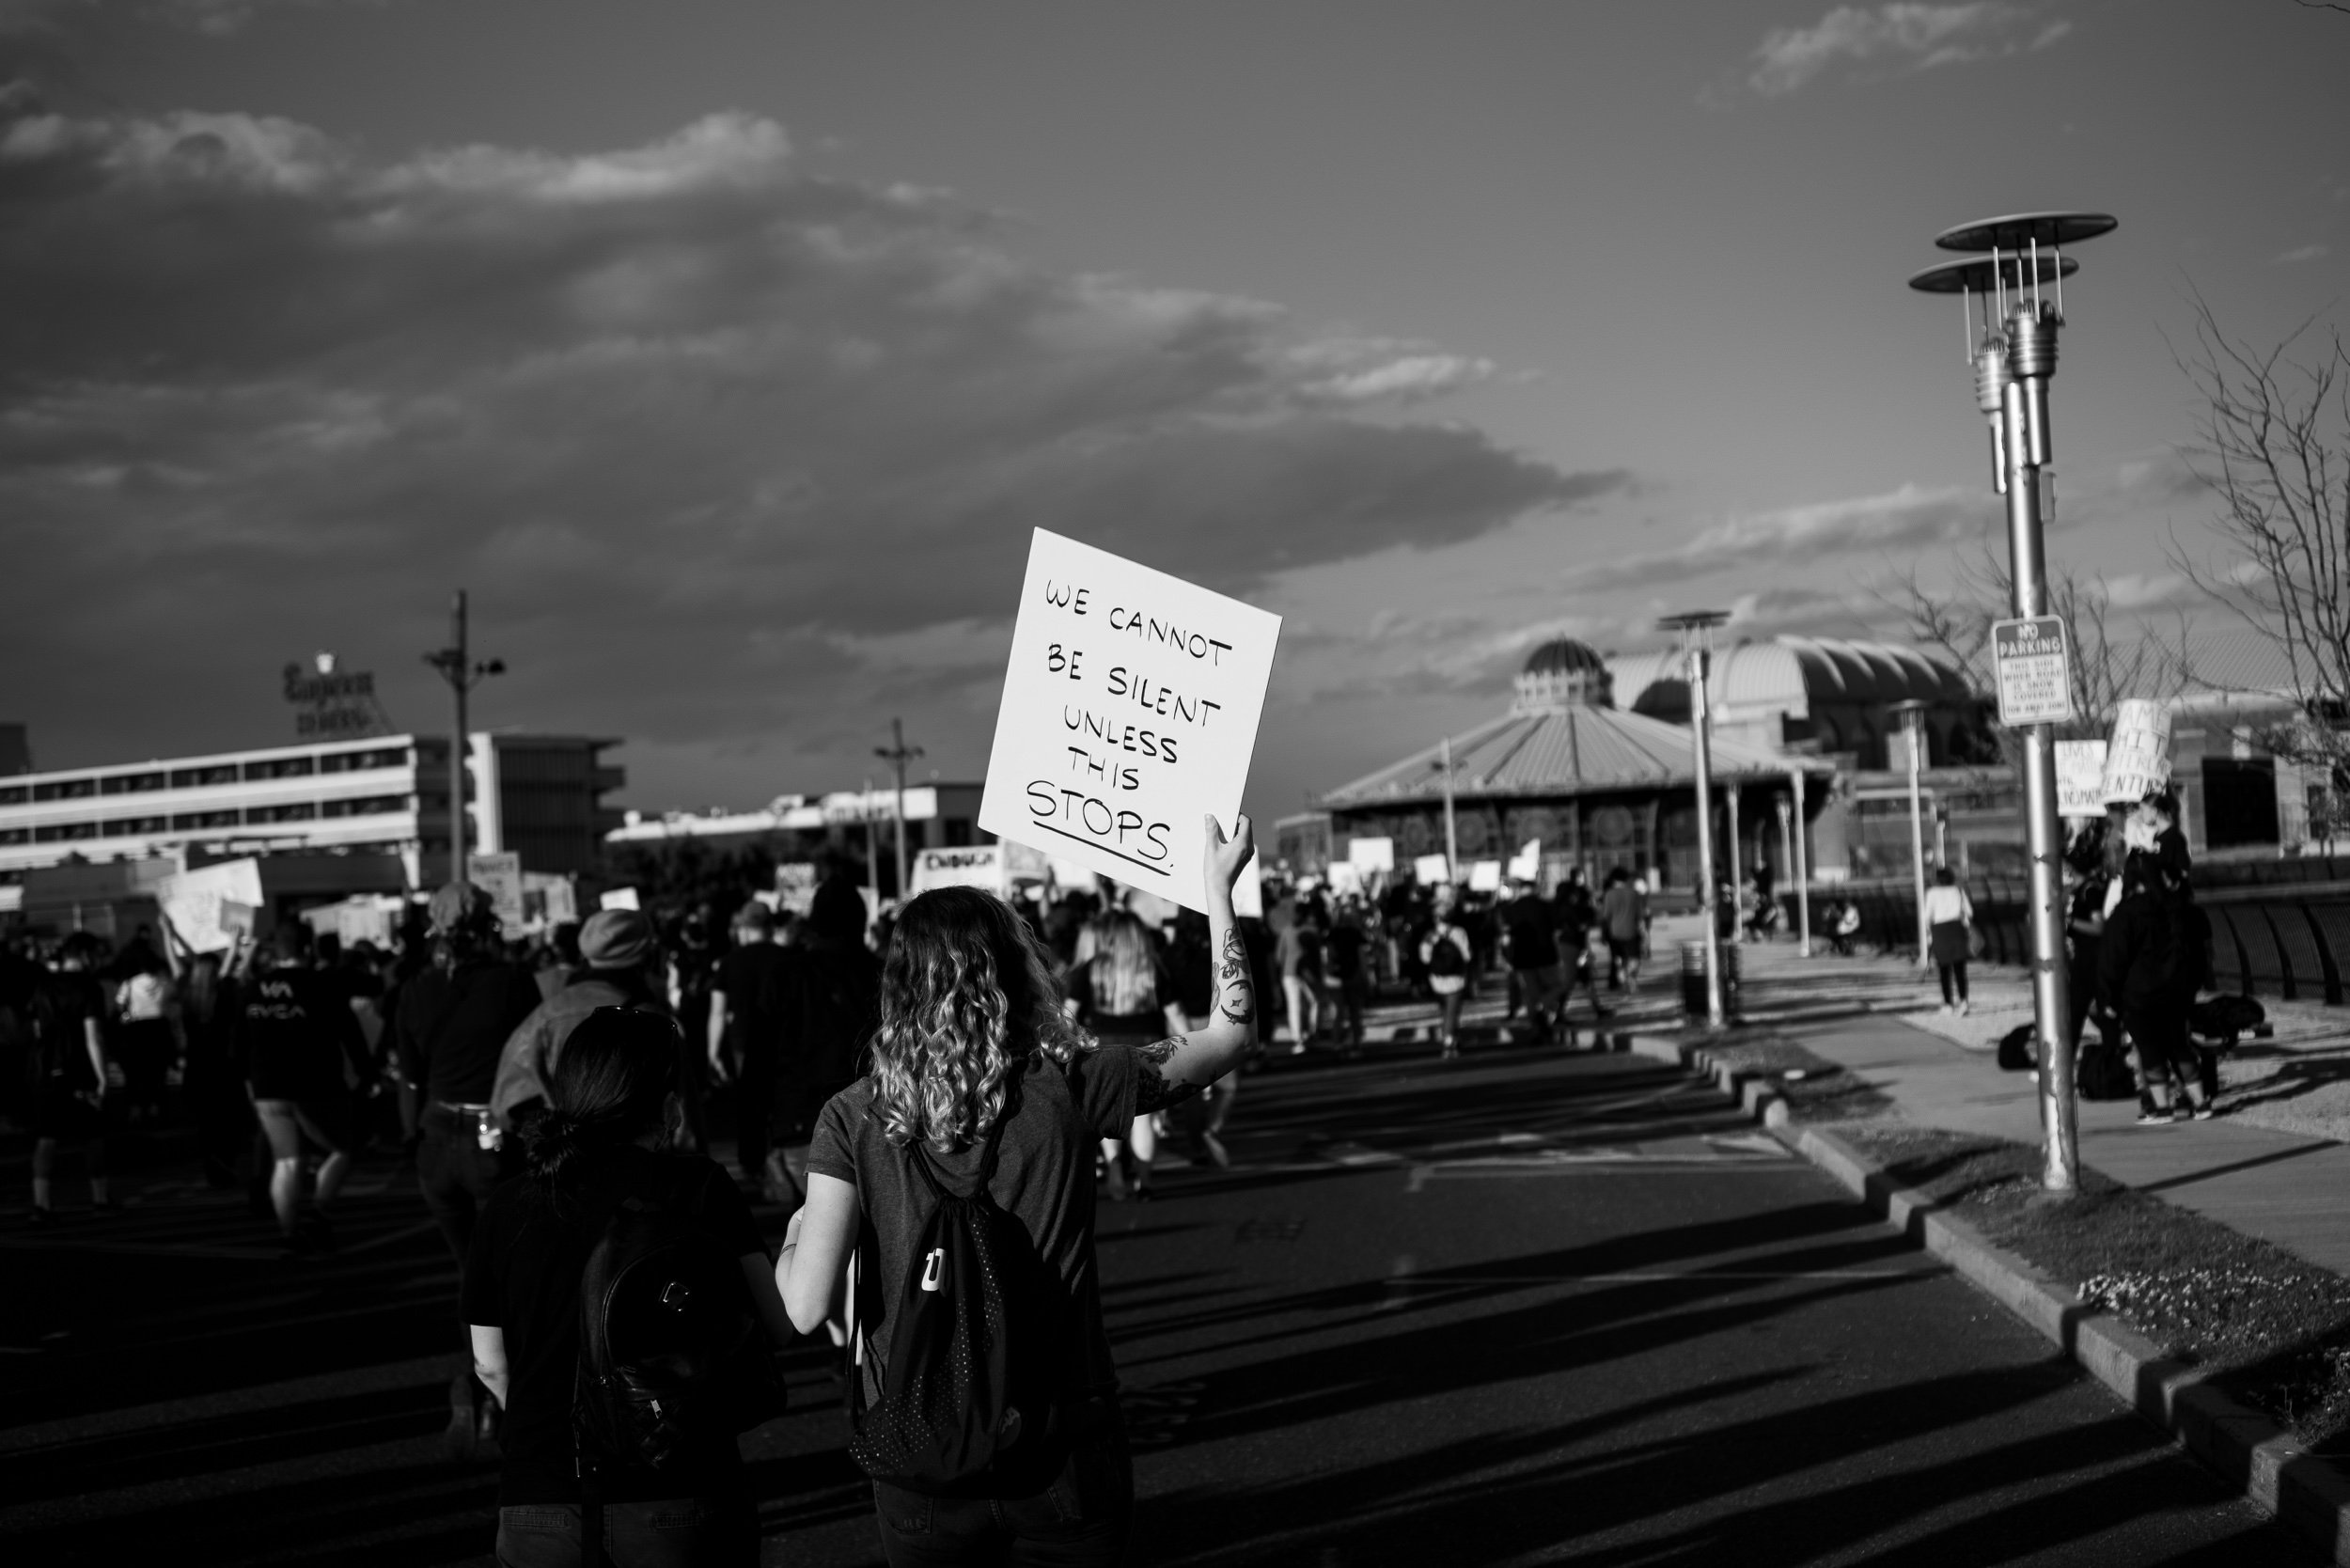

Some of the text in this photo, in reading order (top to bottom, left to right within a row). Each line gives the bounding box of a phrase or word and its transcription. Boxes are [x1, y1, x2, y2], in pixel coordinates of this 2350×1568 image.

[1046, 579, 1233, 666] WE CANNOT
[2018, 623, 2039, 640] NO
[1998, 636, 2060, 657] PARKING
[2010, 659, 2054, 670] THIS SIDE
[2004, 668, 2062, 682] WHEN ROAD
[1048, 643, 1221, 727] BE SILENT
[2013, 680, 2055, 691] IS SNOW
[2013, 690, 2057, 700] COVERED
[2007, 701, 2065, 714] TOW AWAY ZONE
[1064, 705, 1178, 764] UNLESS
[1067, 745, 1139, 791] THIS
[1026, 779, 1174, 868] STOPS.
